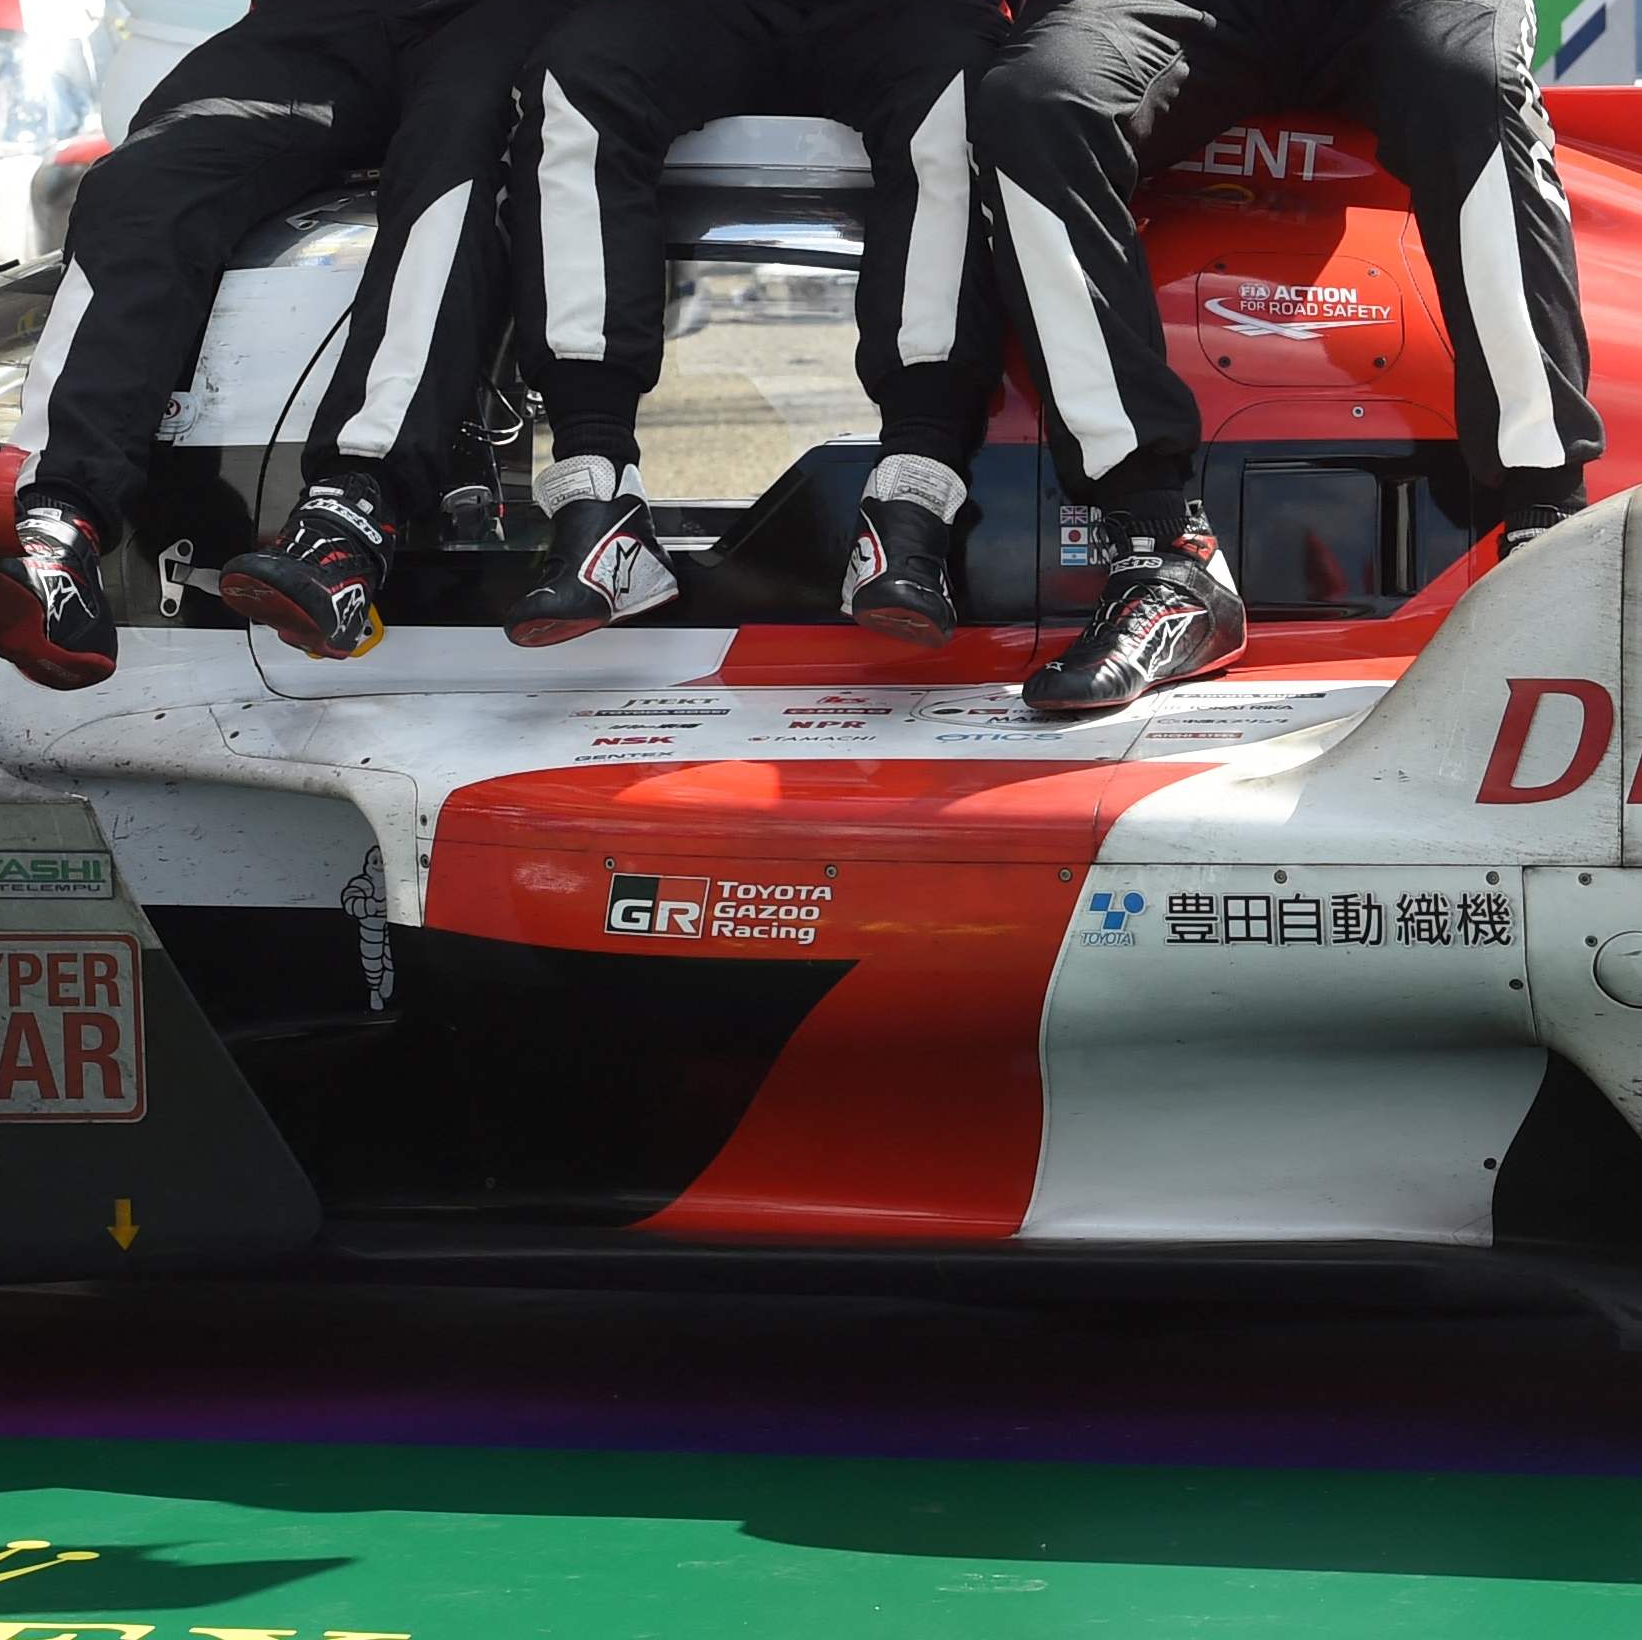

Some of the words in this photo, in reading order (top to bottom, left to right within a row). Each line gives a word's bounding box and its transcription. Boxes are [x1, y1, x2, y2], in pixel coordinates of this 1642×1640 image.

[1166, 125, 1335, 183] ENT
[1239, 284, 1268, 300] FIA
[1272, 285, 1358, 303] ACTION
[1239, 299, 1267, 313] FOR
[1268, 301, 1320, 317] ROAD
[1322, 303, 1392, 321] SAFETY
[620, 697, 721, 709] JTEKT
[787, 720, 868, 729] NPR
[590, 735, 677, 747] NSK
[934, 732, 1064, 743] OTICS
[574, 751, 675, 761] GENTEX
[716, 880, 834, 903] TOYOTA
[610, 898, 703, 934] GR
[713, 901, 821, 922] GAZOO
[1164, 891, 1514, 948] 豊田自動織機
[711, 920, 818, 945] Racing
[1080, 932, 1136, 947] TOYOTA
